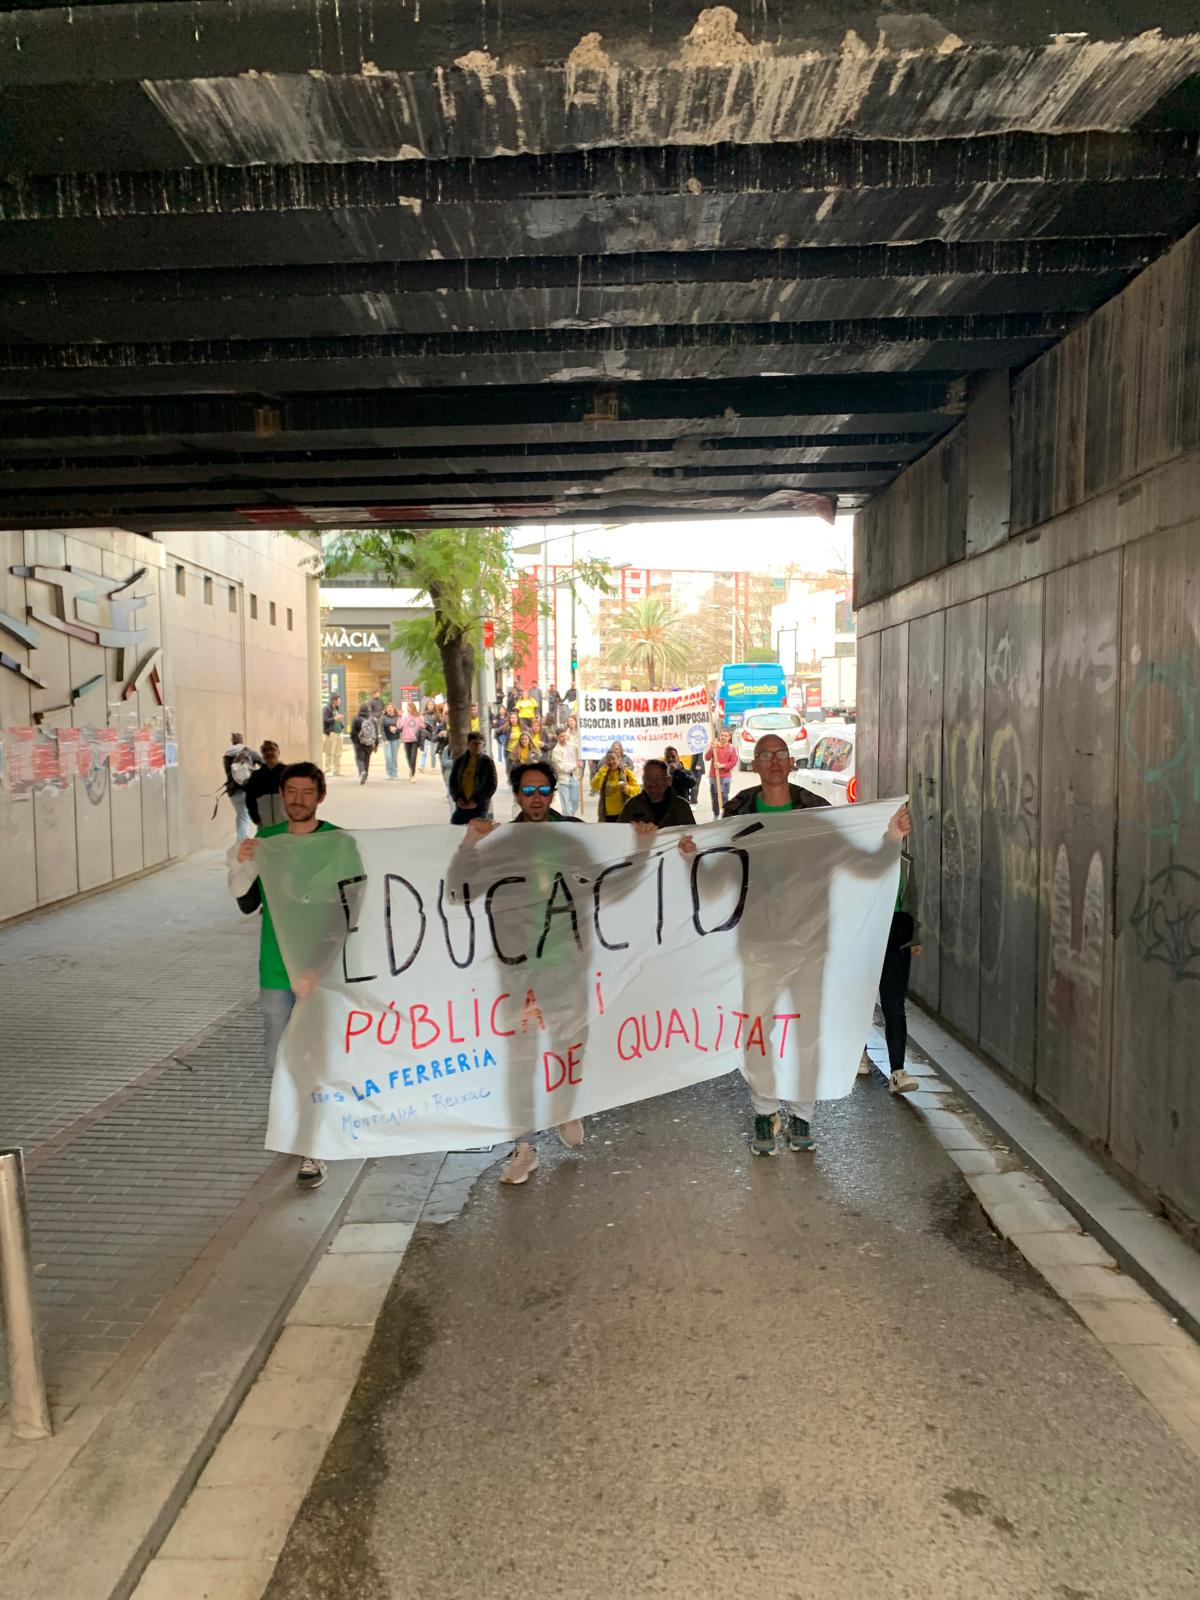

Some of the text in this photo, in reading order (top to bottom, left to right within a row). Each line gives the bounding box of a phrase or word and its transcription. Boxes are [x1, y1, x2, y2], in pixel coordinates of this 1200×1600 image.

[584, 695, 597, 712] ÉS
[599, 698, 613, 712] DE
[616, 698, 650, 712] BONA
[579, 718, 617, 729] ESCOLTAR
[661, 715, 674, 726] NO
[543, 1042, 583, 1093] DE
[351, 1079, 381, 1102] LA
